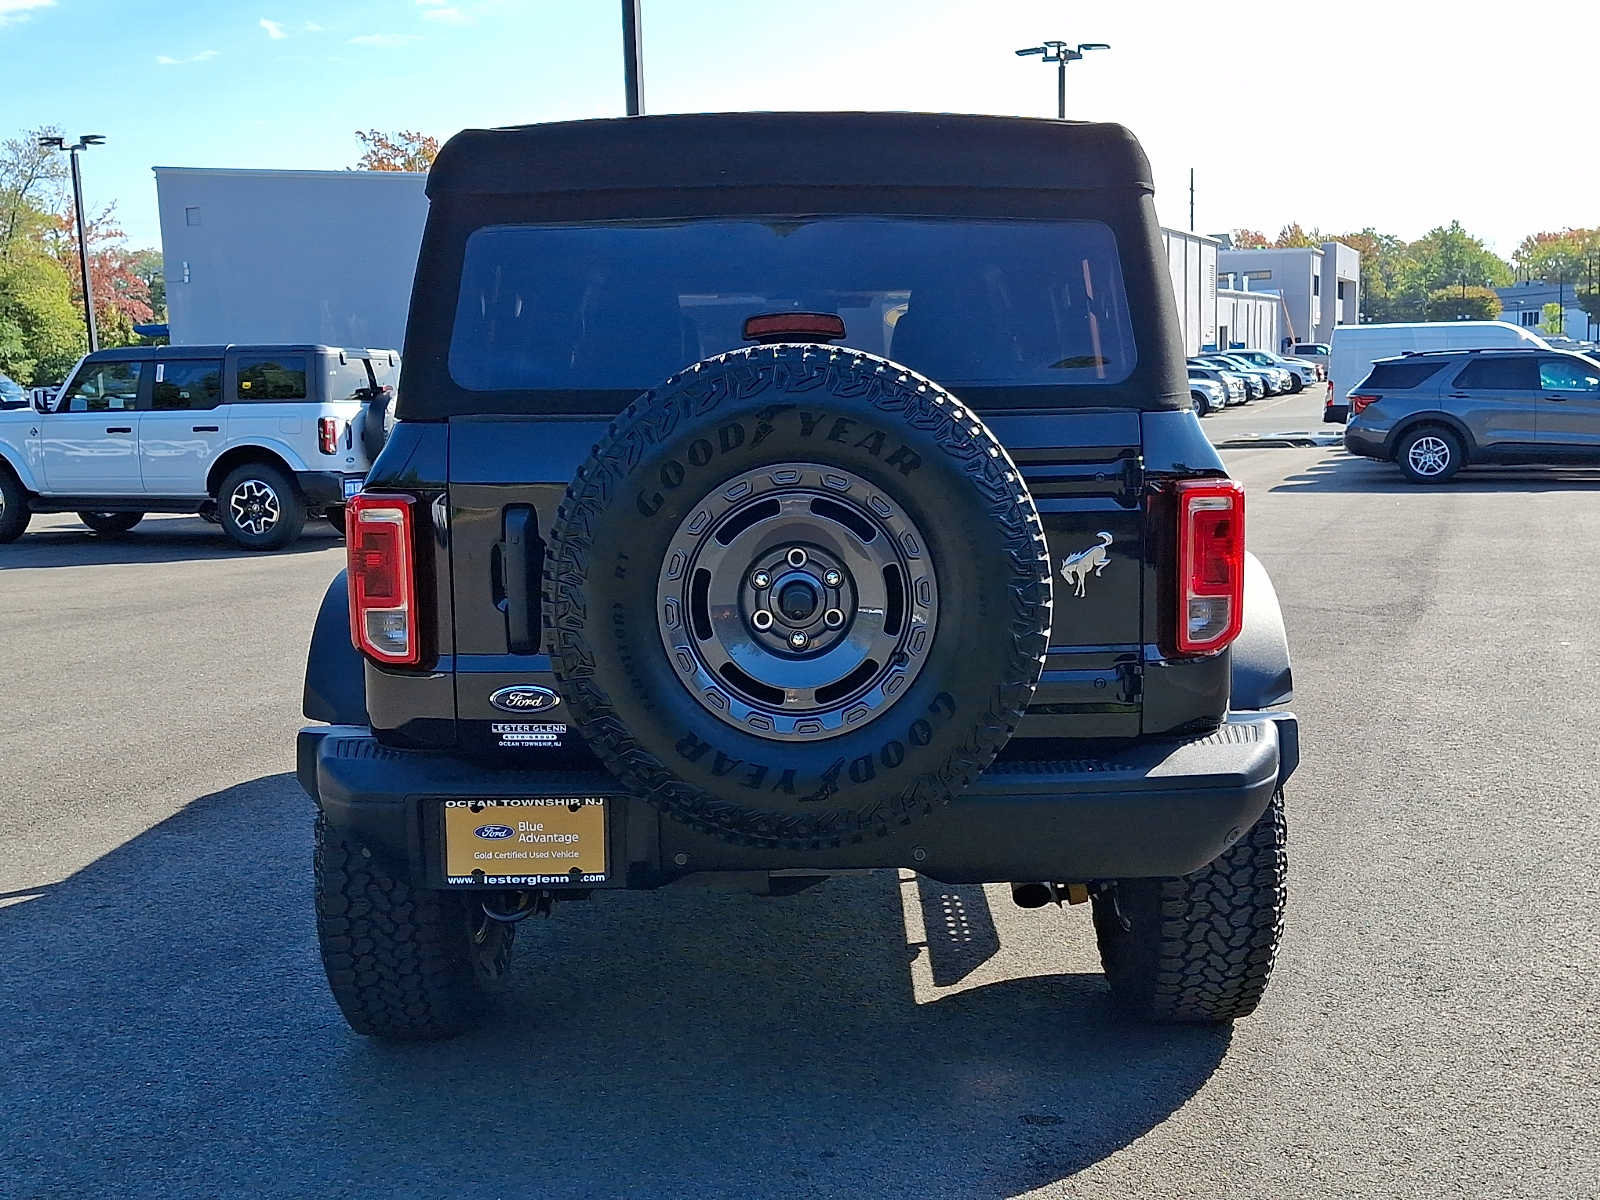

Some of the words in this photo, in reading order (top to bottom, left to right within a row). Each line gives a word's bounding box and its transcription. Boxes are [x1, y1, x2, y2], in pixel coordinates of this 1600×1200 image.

[506, 692, 543, 708] Ford
[492, 724, 530, 732] LESTER
[532, 724, 566, 732] GLENN
[585, 798, 604, 806] NJ
[518, 821, 544, 832] Blue
[481, 827, 508, 838] Ford
[518, 833, 579, 845] Advantage
[474, 851, 493, 860] Gold
[494, 851, 528, 860] Certified
[529, 851, 549, 860] Used
[551, 850, 579, 859] Vehicle
